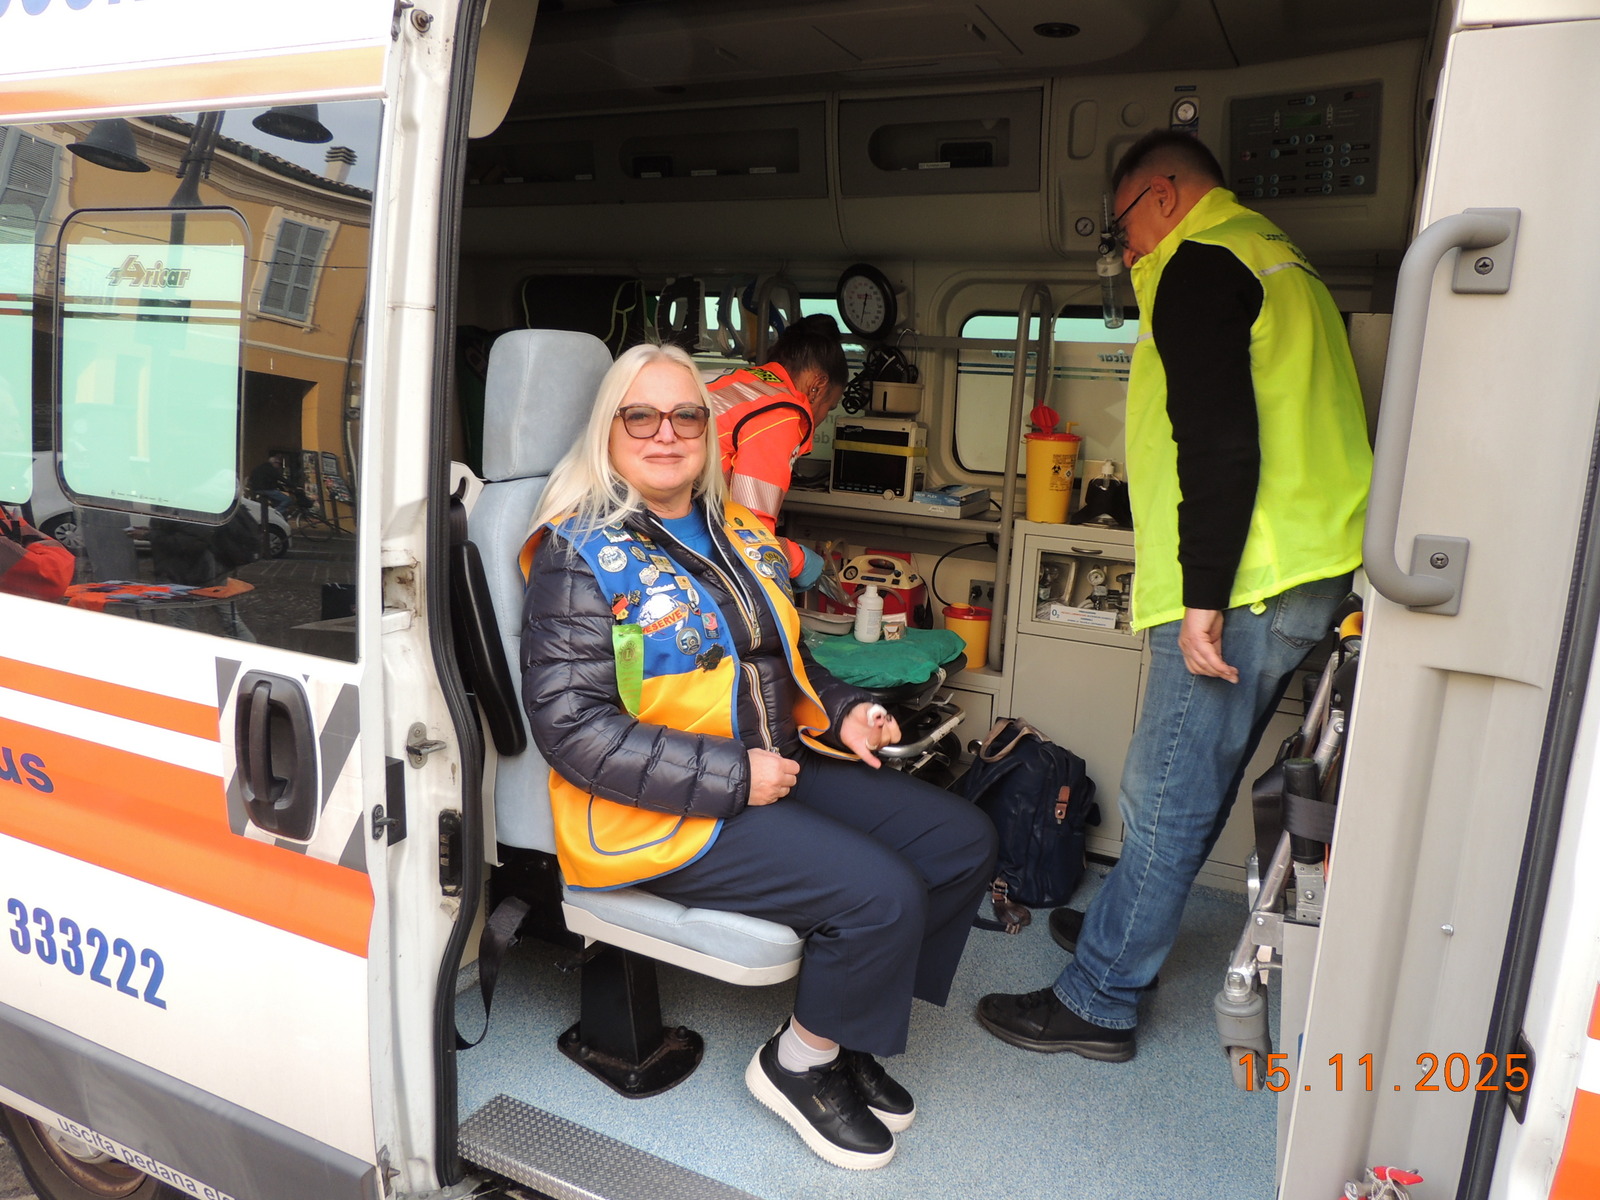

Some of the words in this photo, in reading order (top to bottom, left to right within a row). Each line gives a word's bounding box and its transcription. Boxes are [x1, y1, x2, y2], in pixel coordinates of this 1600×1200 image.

[105, 254, 192, 288] Aricar
[7, 898, 167, 1010] 333222
[58, 1118, 116, 1155] uscita
[121, 1147, 198, 1194] pedana
